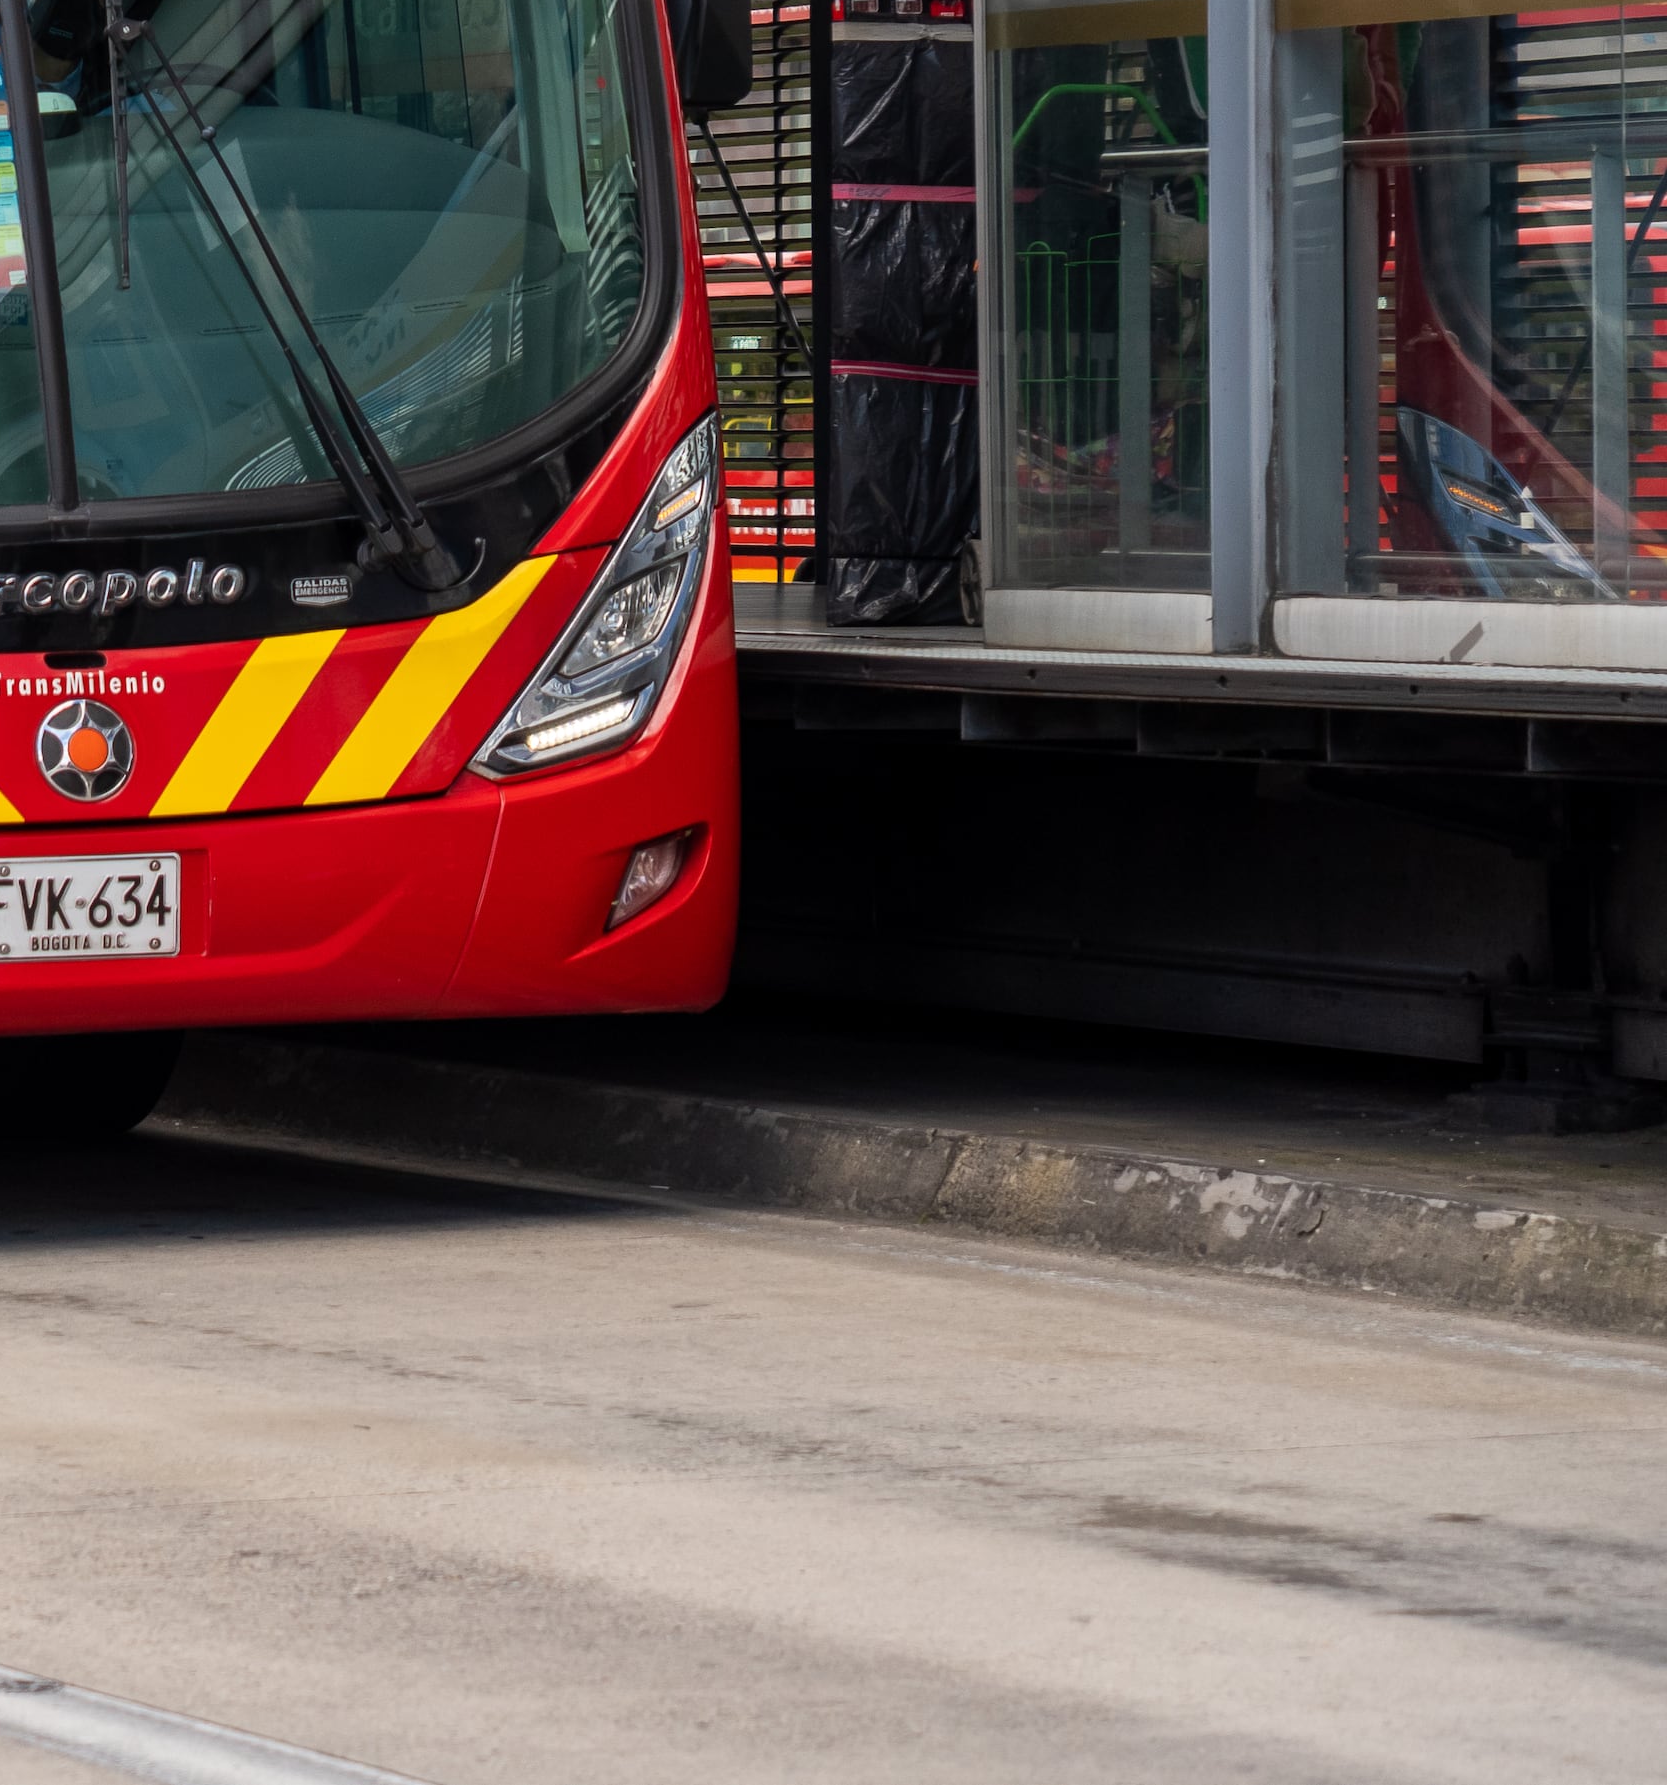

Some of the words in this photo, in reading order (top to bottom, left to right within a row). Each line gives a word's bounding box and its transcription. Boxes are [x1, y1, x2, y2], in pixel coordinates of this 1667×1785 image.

[295, 578, 347, 588] SALIDAS
[295, 586, 348, 596] EMERGENCIA
[31, 934, 92, 952] BOGOTA
